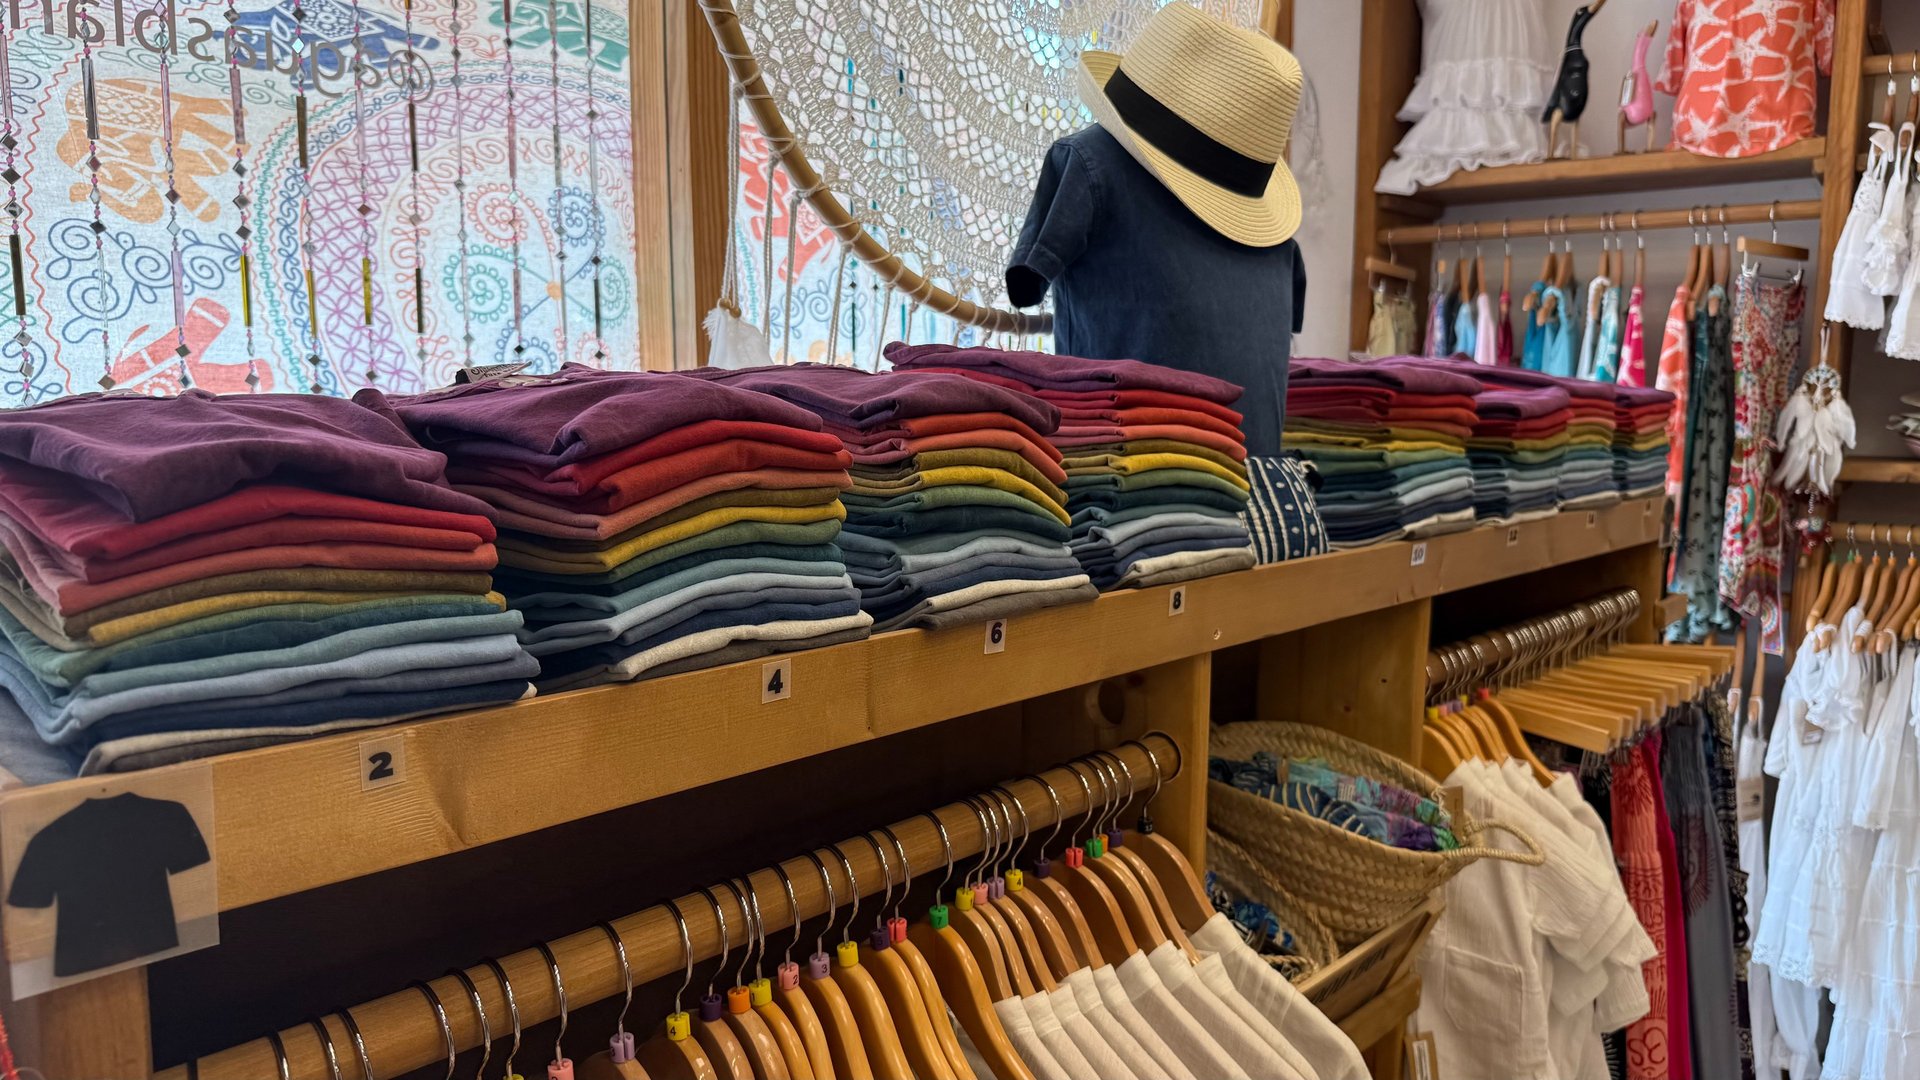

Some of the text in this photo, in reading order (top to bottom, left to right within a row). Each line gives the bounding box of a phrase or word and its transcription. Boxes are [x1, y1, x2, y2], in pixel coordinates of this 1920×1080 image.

[1413, 547, 1425, 562] 10
[1172, 591, 1182, 610] 8
[991, 621, 1003, 644] 6
[767, 668, 784, 694] 4
[368, 751, 394, 781] 2
[937, 916, 943, 926] 7
[821, 963, 828, 974] 3
[792, 974, 799, 986] 2
[670, 1025, 677, 1036] 4
